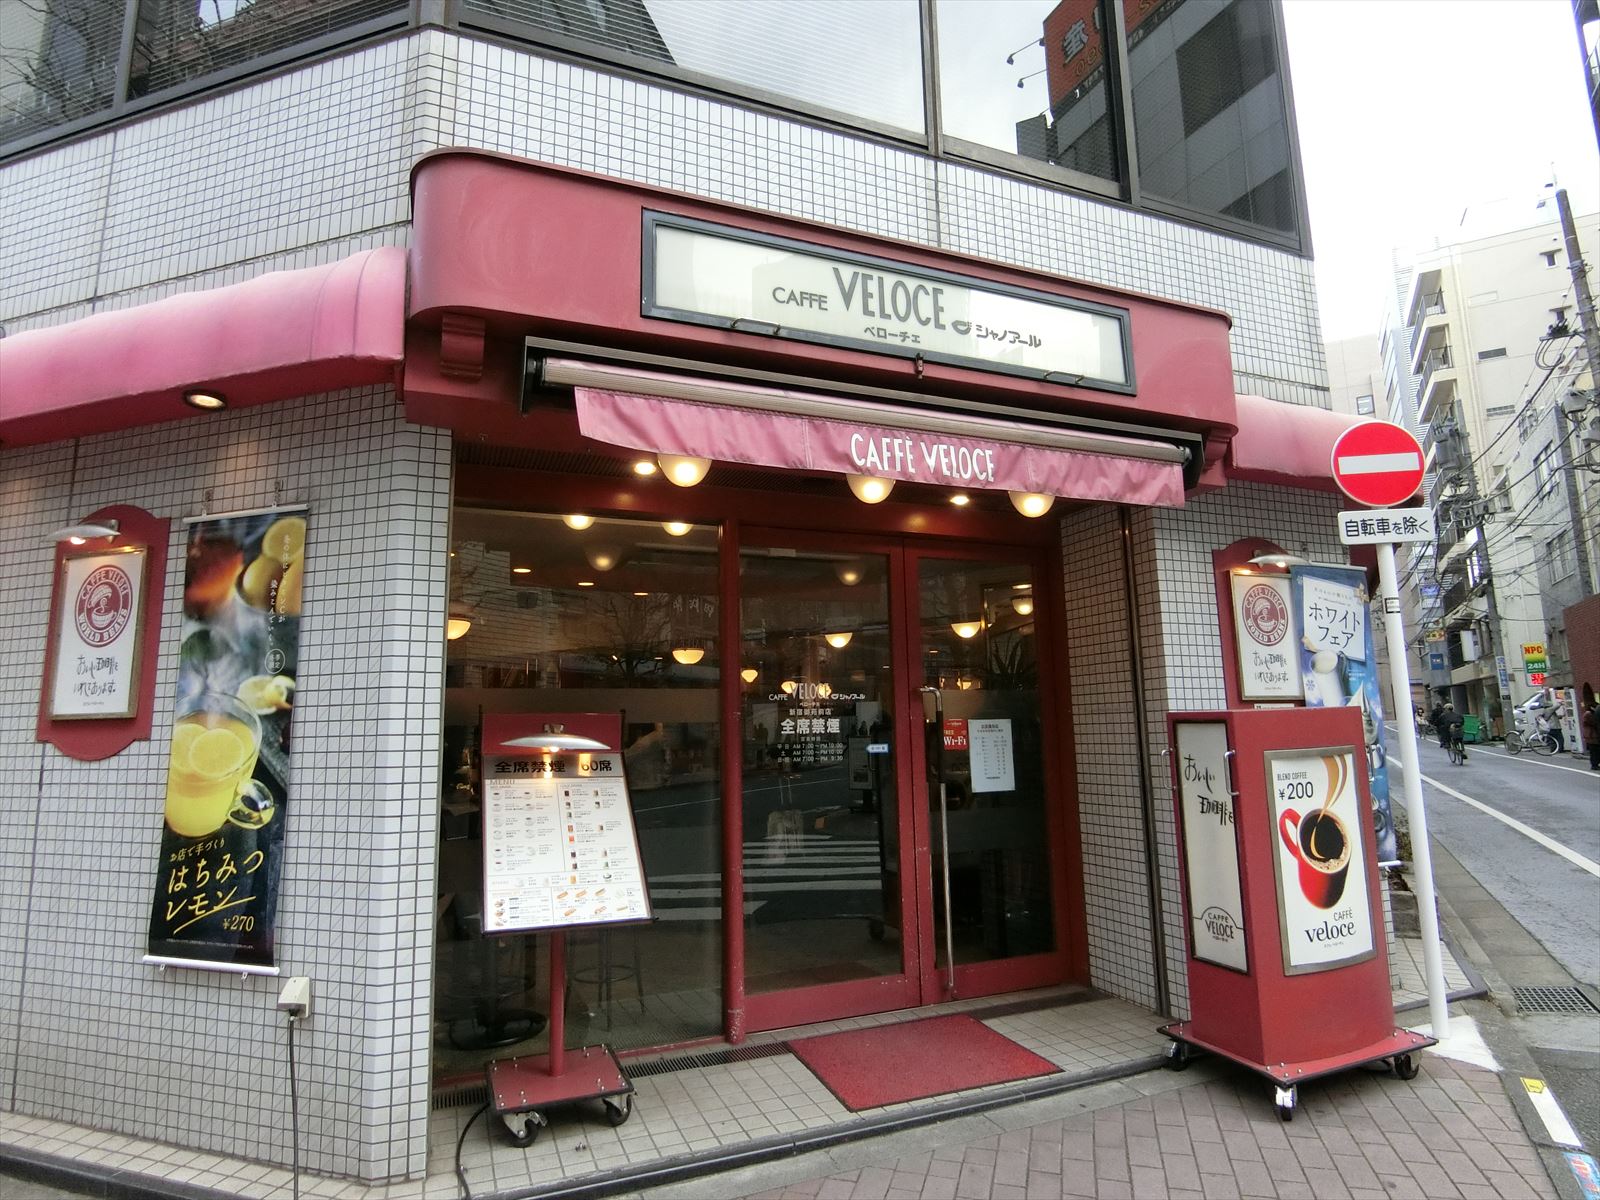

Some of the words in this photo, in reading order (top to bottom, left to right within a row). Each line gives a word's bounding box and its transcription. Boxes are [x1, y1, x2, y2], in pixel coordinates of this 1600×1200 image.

[772, 286, 828, 311] CAFFE
[832, 267, 946, 330] VELOCE
[864, 326, 921, 344] ベローチェ
[975, 324, 1041, 348] シャノアール
[850, 433, 916, 473] CAFFÈ
[920, 441, 994, 482] VELOCE
[1345, 515, 1429, 538] 自転車を除く
[78, 612, 101, 642] WORLD
[103, 608, 128, 641] BEANS
[1309, 602, 1360, 633] ホワイト
[1317, 624, 1354, 649] フェア
[1524, 646, 1542, 654] NPC
[789, 682, 830, 700] VELOCE
[781, 718, 840, 734] 全席禁煙
[943, 736, 967, 746] Wi-Fi
[494, 760, 566, 774] 全席禁煙
[1277, 772, 1291, 781] BLEND
[1292, 770, 1308, 780] COFFEE
[1278, 781, 1314, 801] ¥200
[170, 837, 225, 862] お店で手づくり
[168, 850, 264, 894] はちみつ
[166, 886, 238, 921] レモン
[223, 915, 254, 932] ¥270
[1208, 912, 1229, 923] CAFFE
[1333, 907, 1353, 923] CAFFÈ
[1204, 919, 1234, 939] VELOCE
[1304, 920, 1357, 943] veloce
